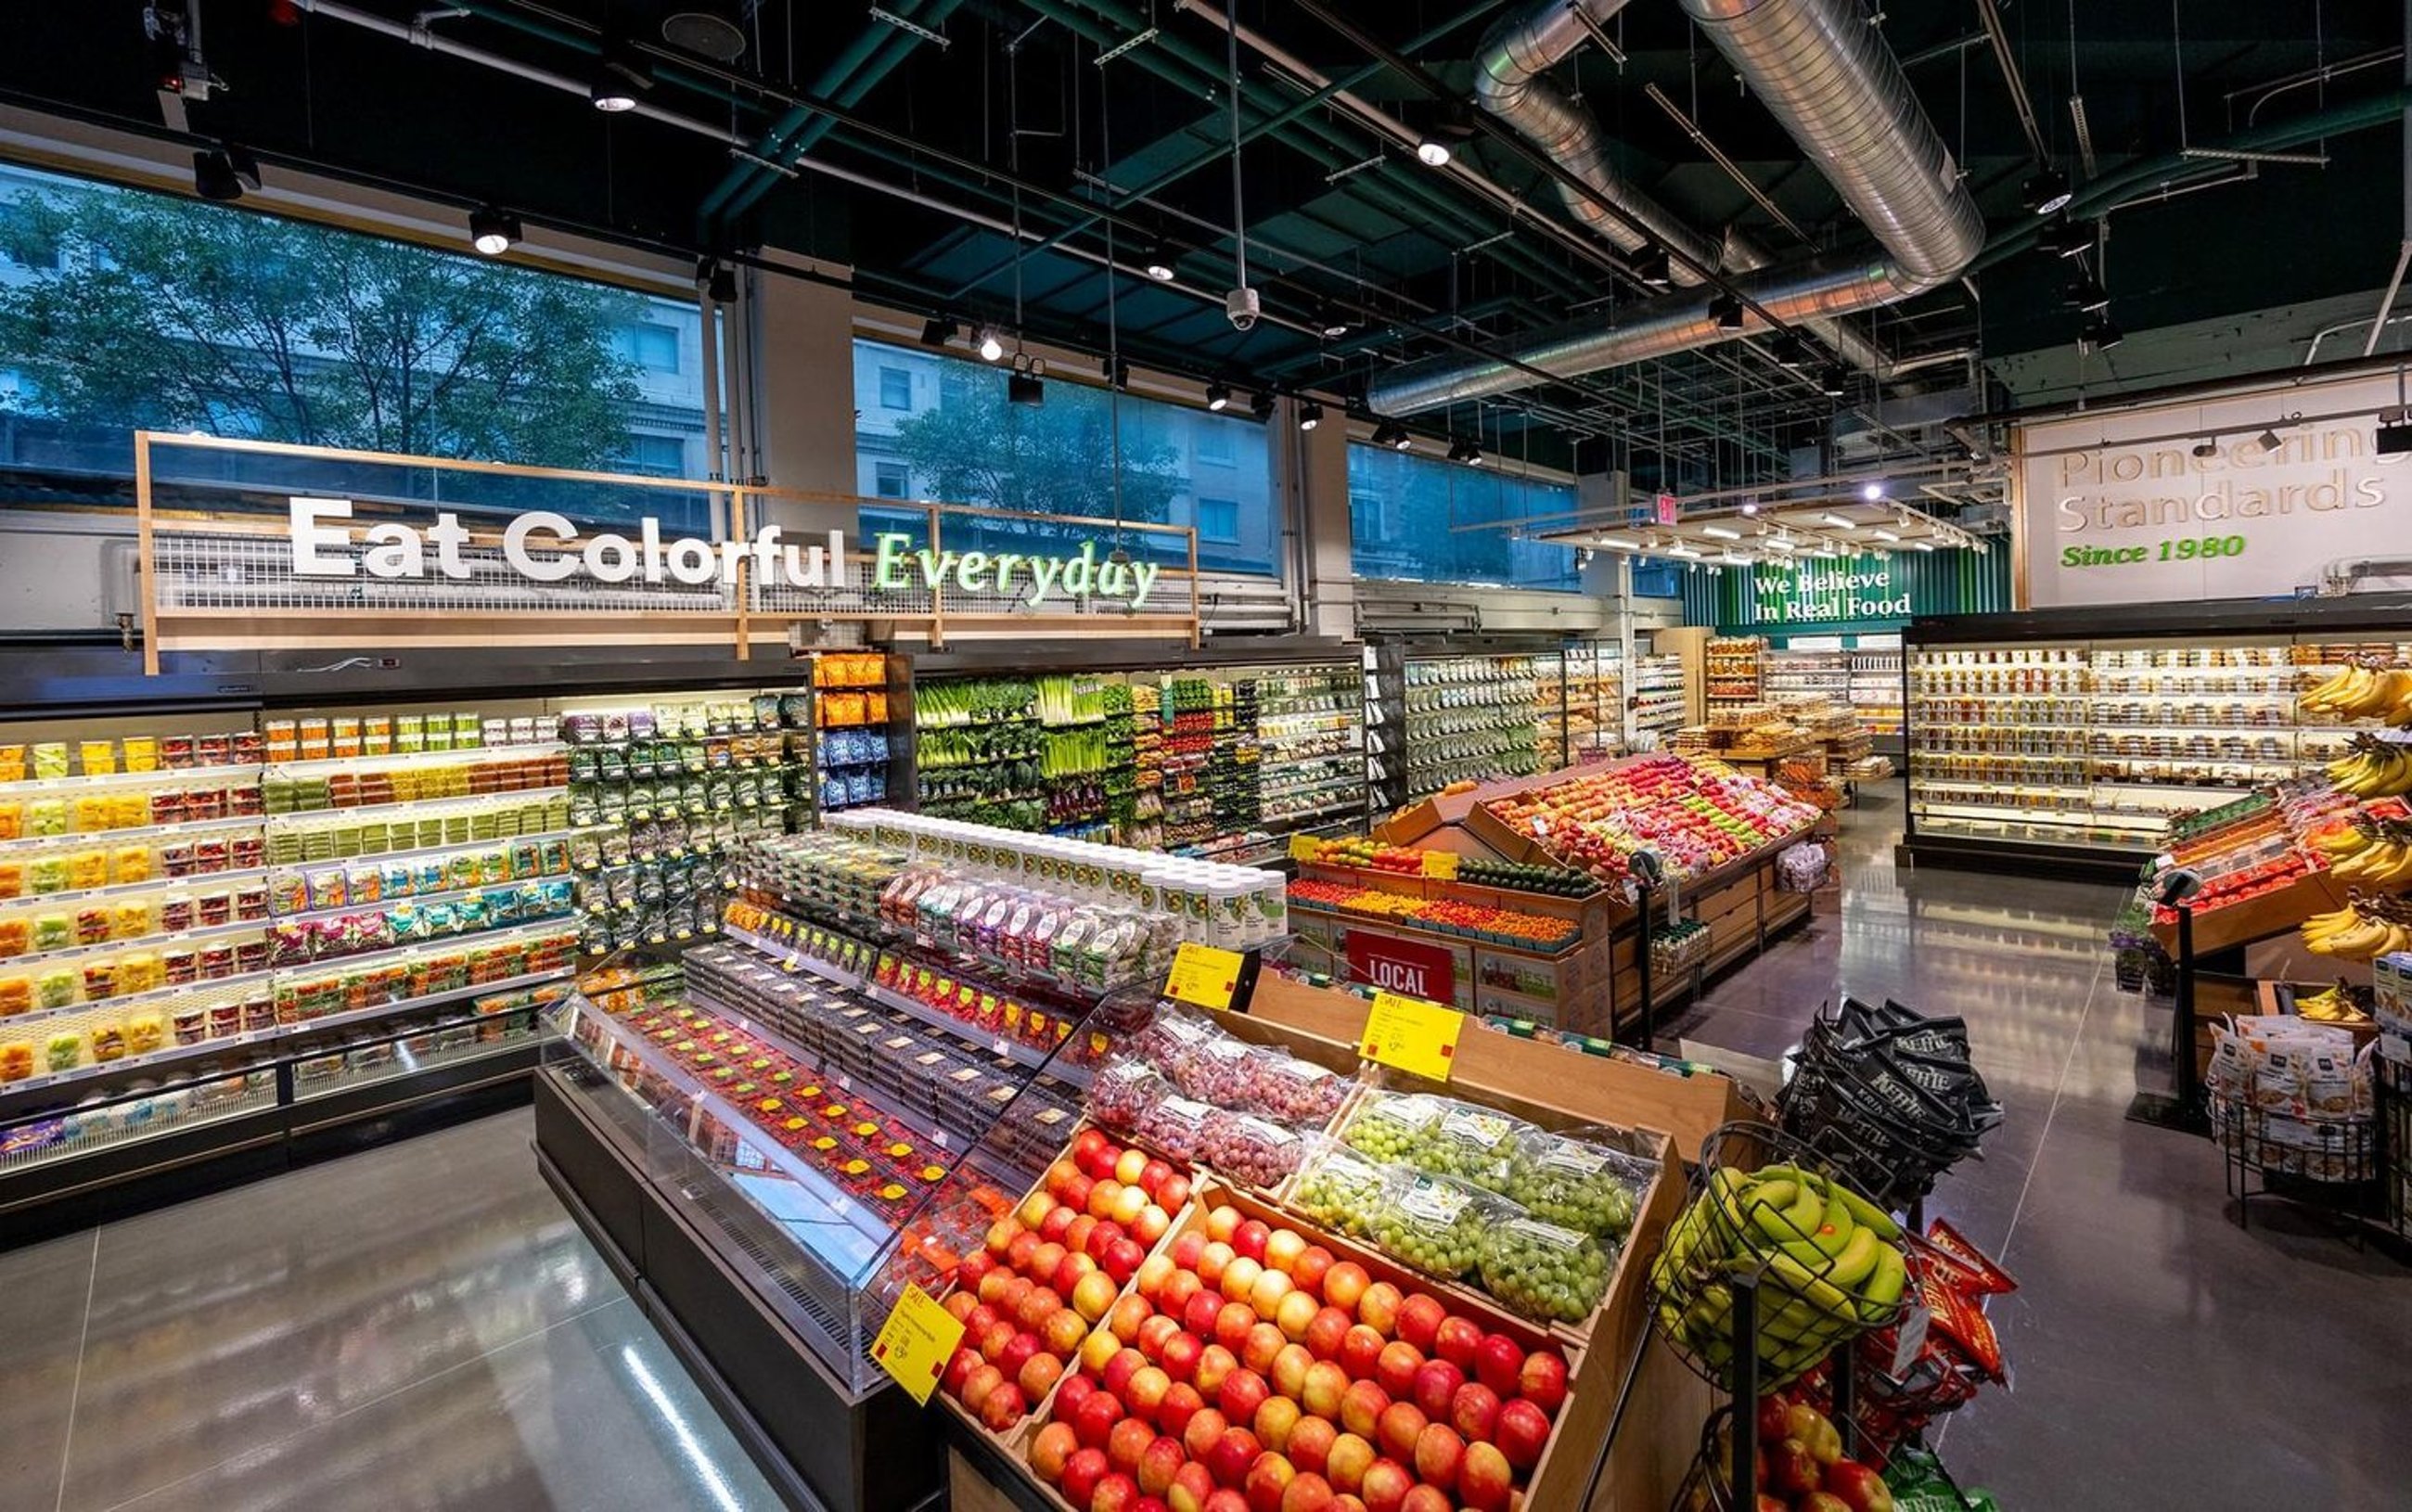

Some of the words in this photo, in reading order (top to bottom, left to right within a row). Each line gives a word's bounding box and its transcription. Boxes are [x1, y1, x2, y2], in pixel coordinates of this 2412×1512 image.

[2061, 424, 2412, 488] Pioneerin
[2059, 468, 2386, 533] Standards
[289, 497, 471, 579] Eat
[504, 510, 845, 588] Colorful
[873, 532, 1159, 609] Everyday
[2060, 544, 2148, 568] Since
[2158, 535, 2245, 562] 1980
[1754, 575, 1791, 595] We
[1798, 570, 1891, 594] Believe
[1755, 603, 1778, 621] In
[1786, 596, 1841, 620] Real
[1847, 593, 1912, 617] Food
[1368, 959, 1429, 997] LOCAL
